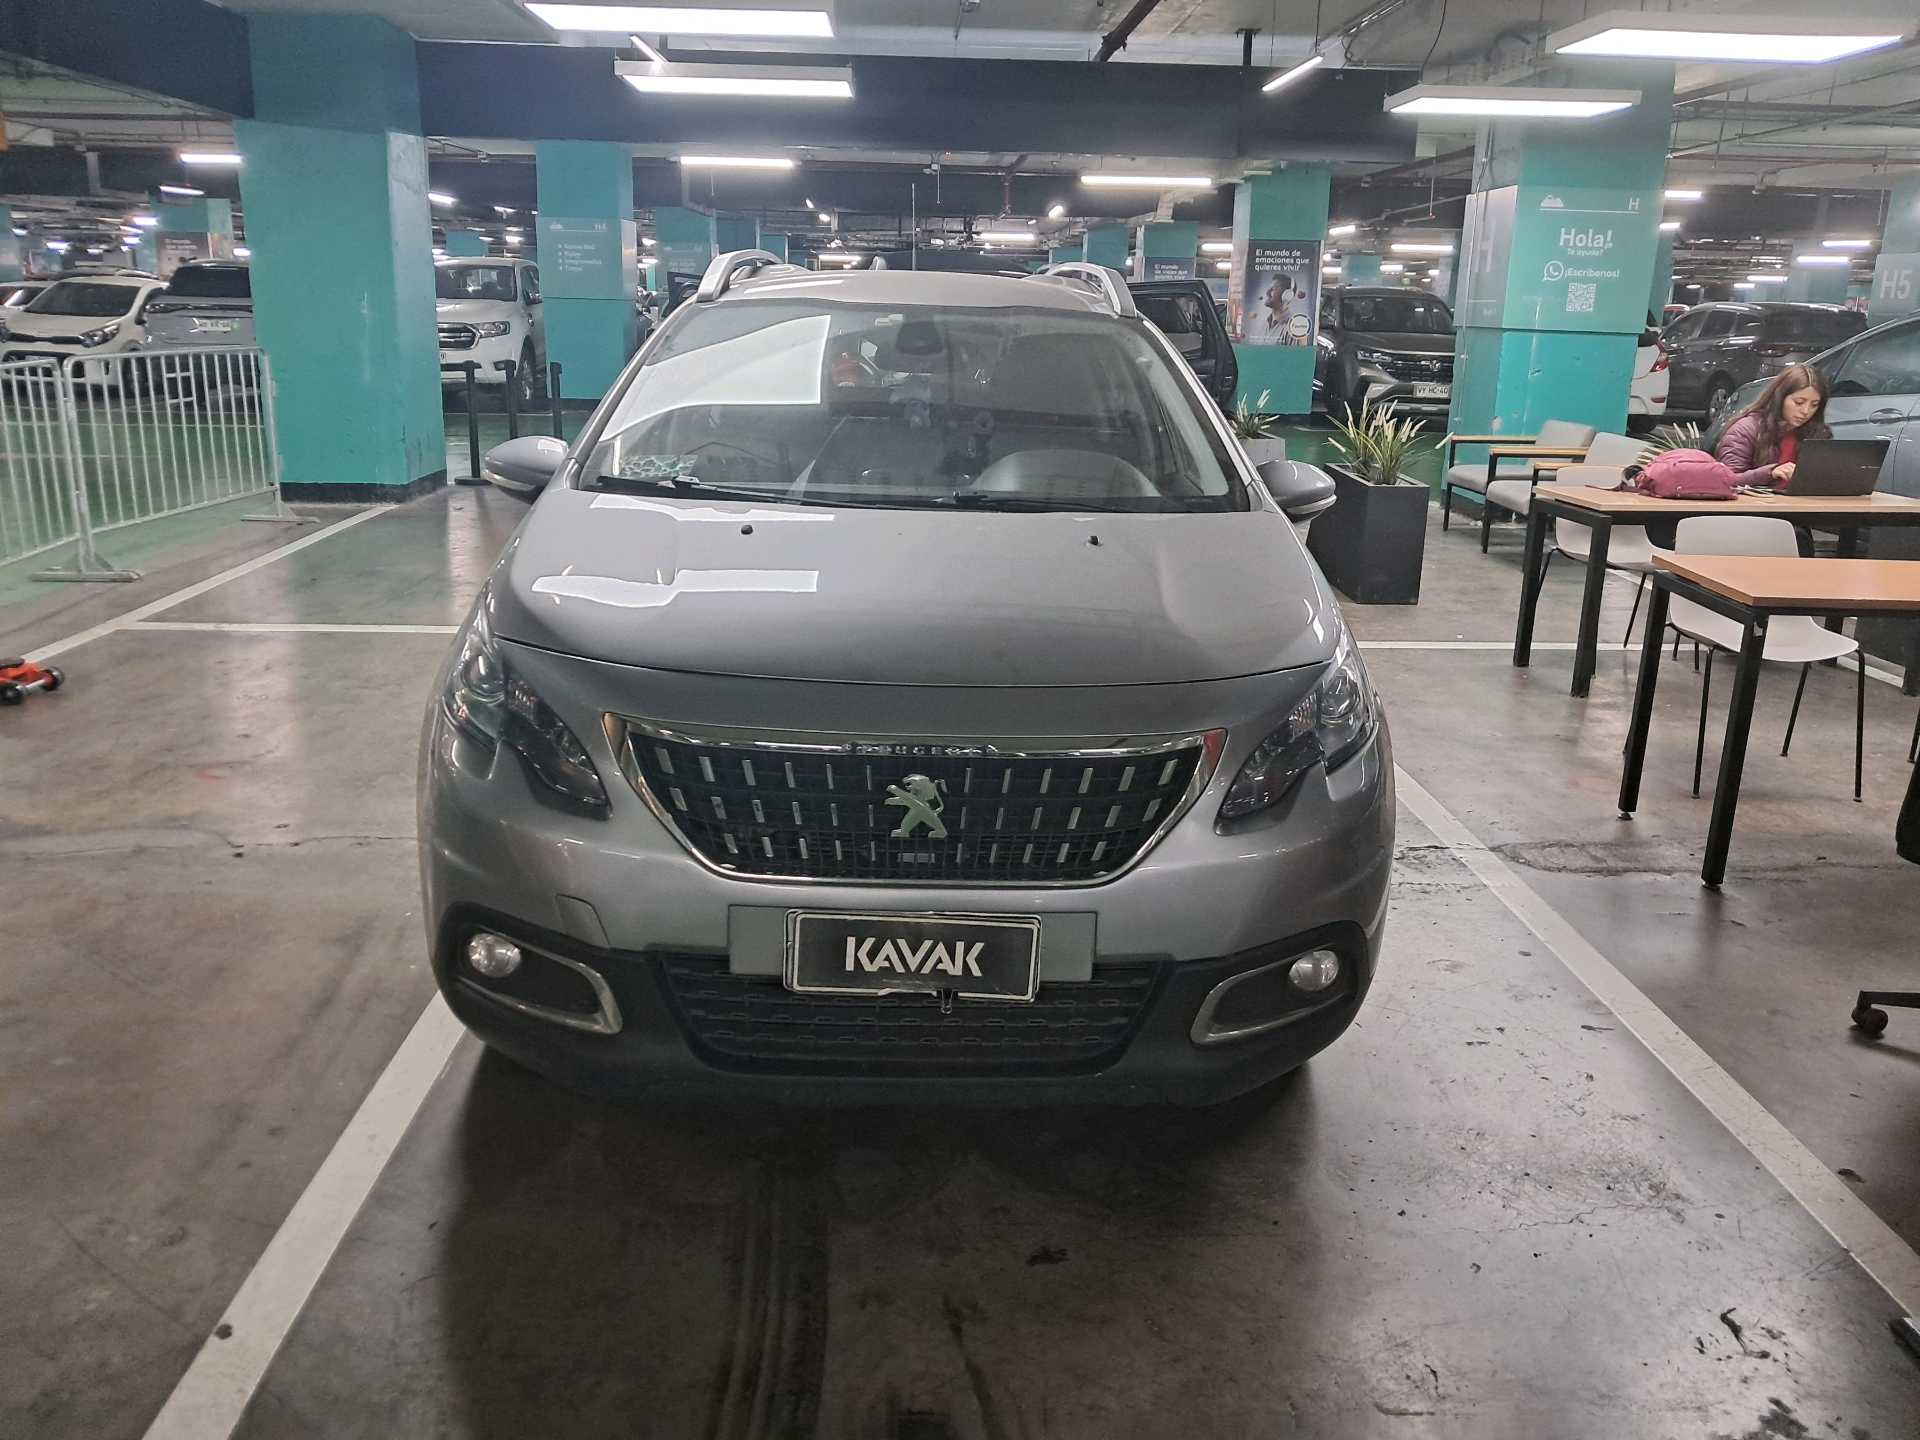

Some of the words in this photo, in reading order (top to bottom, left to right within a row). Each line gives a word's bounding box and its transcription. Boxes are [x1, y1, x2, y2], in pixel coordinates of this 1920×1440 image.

[1628, 197, 1640, 210] H
[1559, 227, 1613, 249] Hola!
[1255, 248, 1263, 256] El
[1264, 249, 1290, 257] mundo
[1291, 249, 1301, 257] de
[1254, 263, 1281, 271] quieres
[1879, 269, 1912, 299] H5
[845, 936, 985, 977] KAVAK
